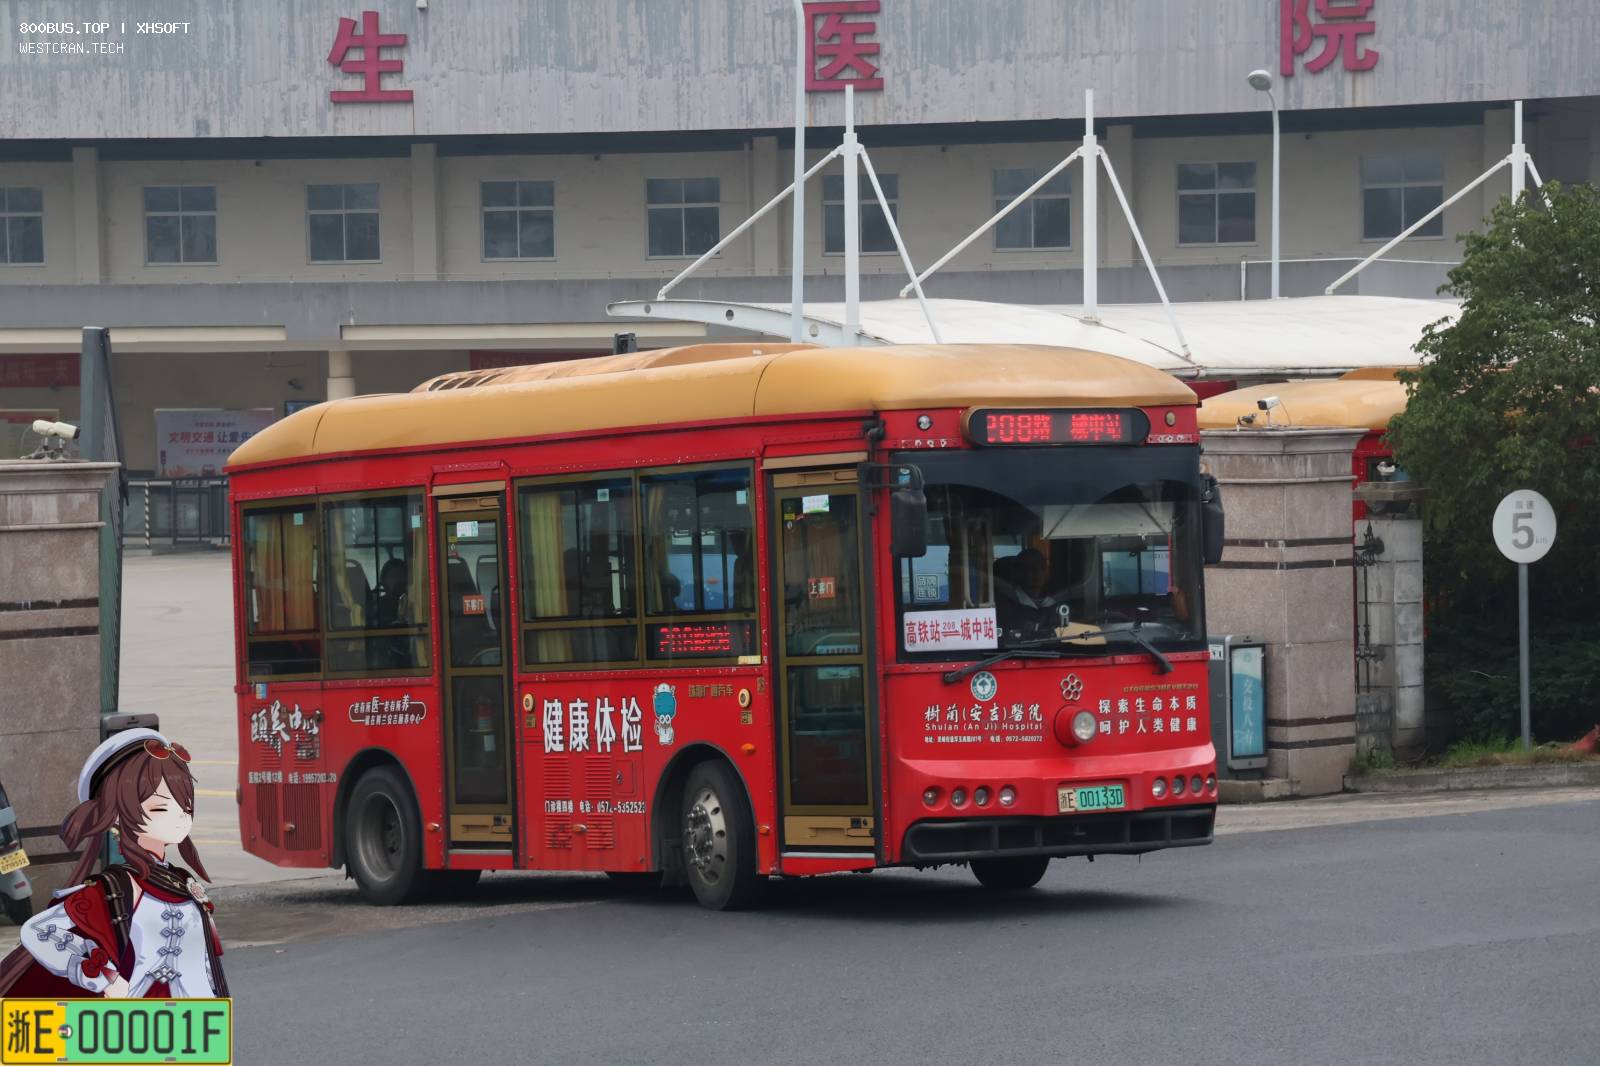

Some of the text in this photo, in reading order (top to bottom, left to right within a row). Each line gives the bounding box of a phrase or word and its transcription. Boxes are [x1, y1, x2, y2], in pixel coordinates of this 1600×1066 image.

[326, 0, 1380, 105] 生 医 院
[1511, 511, 1535, 550] 5
[906, 619, 941, 644] 高铁站
[961, 617, 995, 642] 城中站
[1098, 695, 1197, 714] 探索生命本质
[543, 697, 643, 753] 健康体检
[925, 723, 959, 731] Shulan
[1001, 722, 1043, 732] Hospital
[1099, 717, 1197, 735] 呵护人类健康
